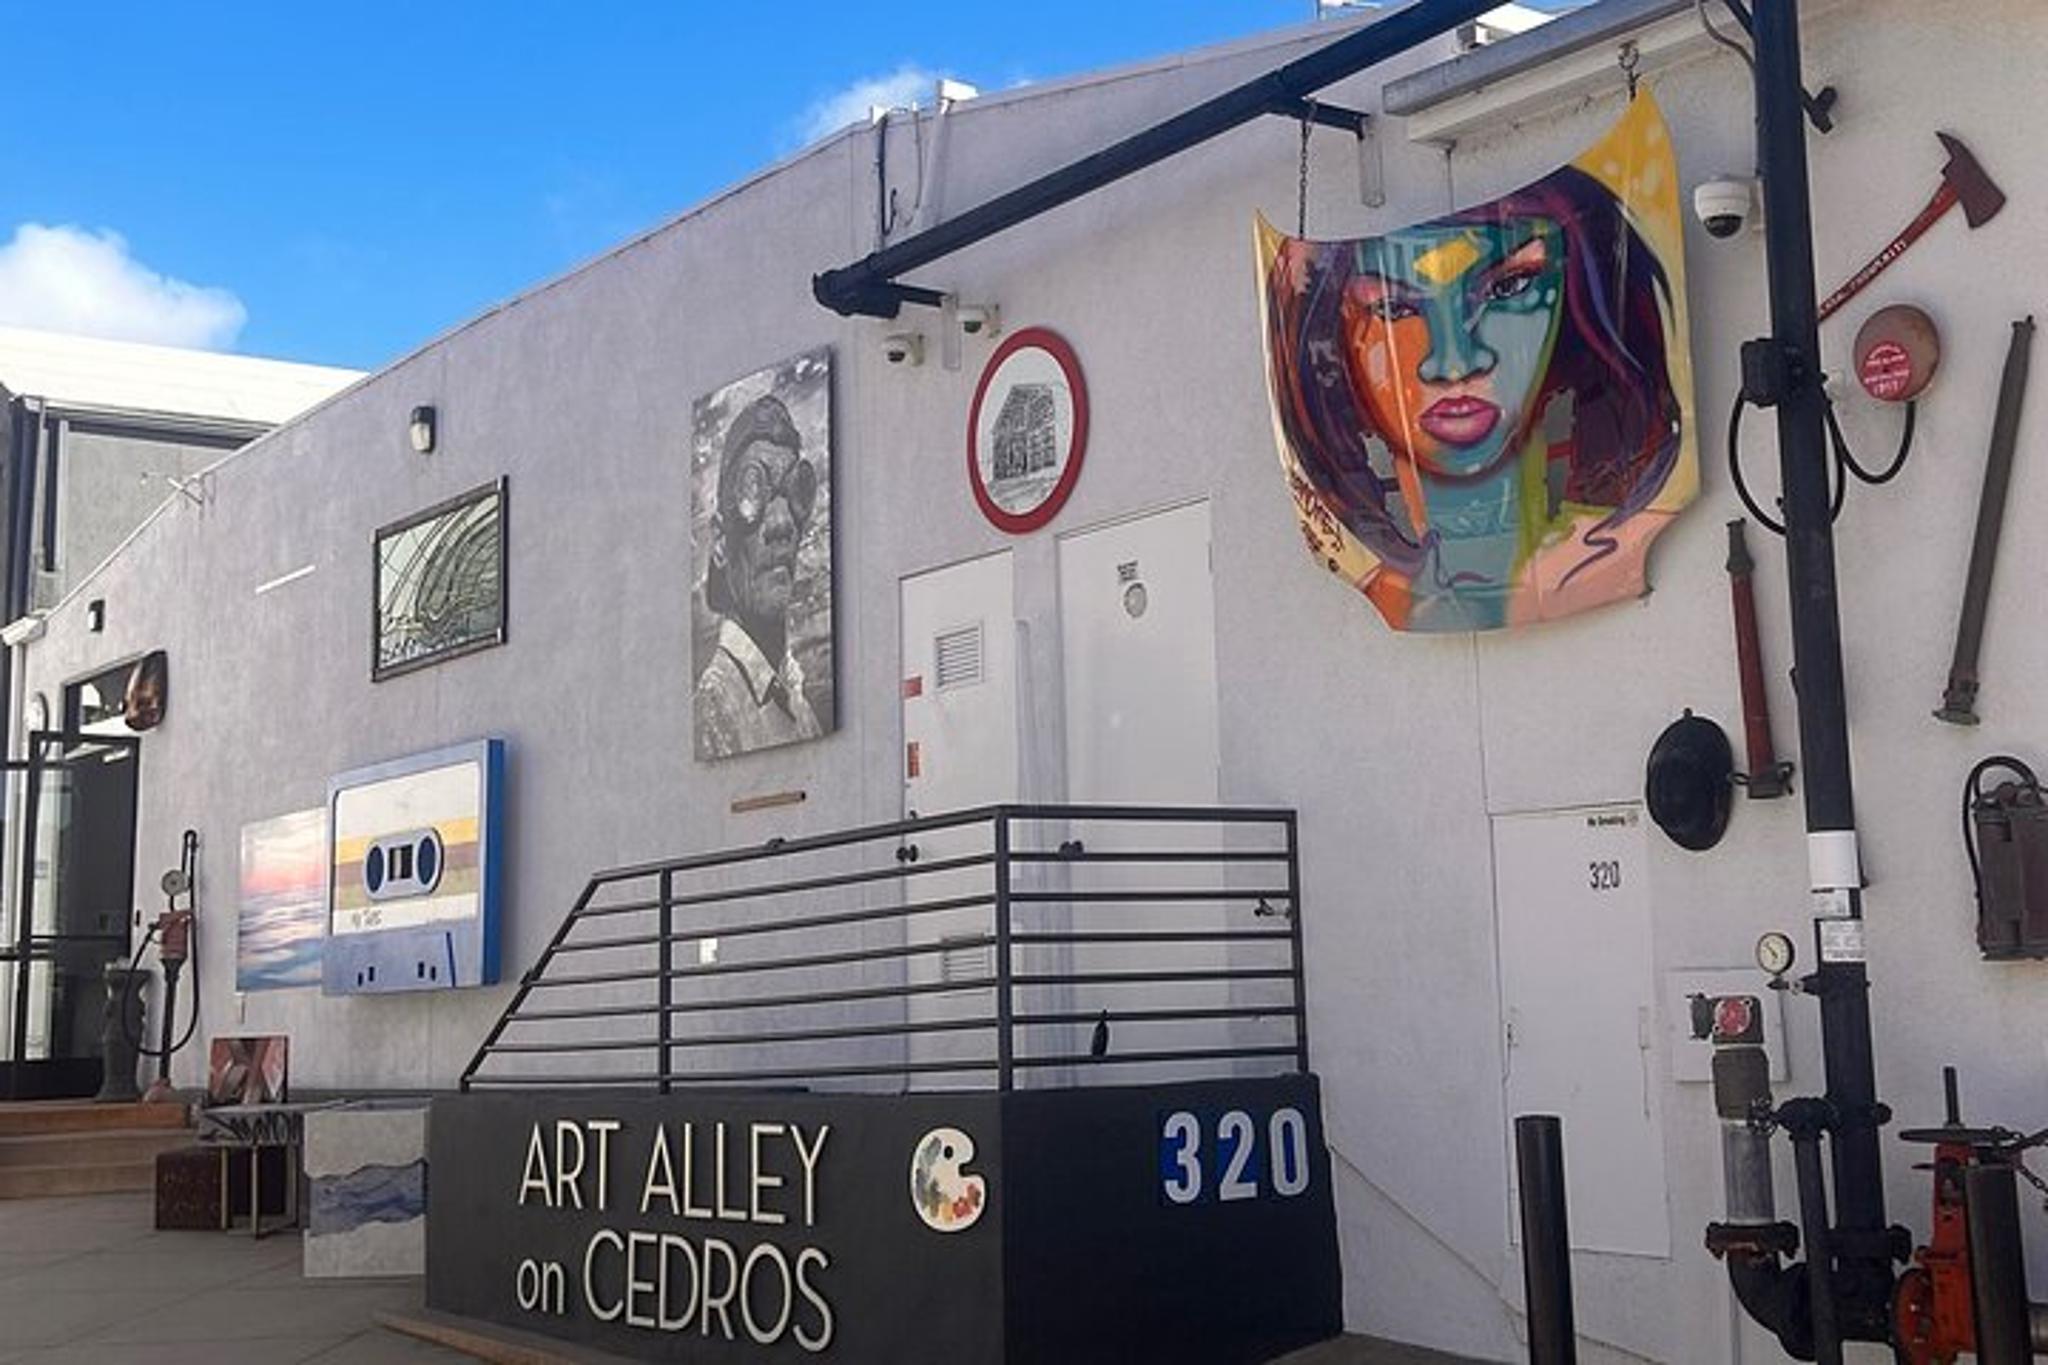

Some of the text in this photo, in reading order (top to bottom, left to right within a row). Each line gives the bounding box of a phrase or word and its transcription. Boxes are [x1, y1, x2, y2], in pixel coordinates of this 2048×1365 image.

[1589, 860, 1620, 889] 320
[518, 1119, 830, 1227] ART ALLEY
[1163, 1107, 1310, 1204] 320
[516, 1228, 834, 1352] on CEDROS
